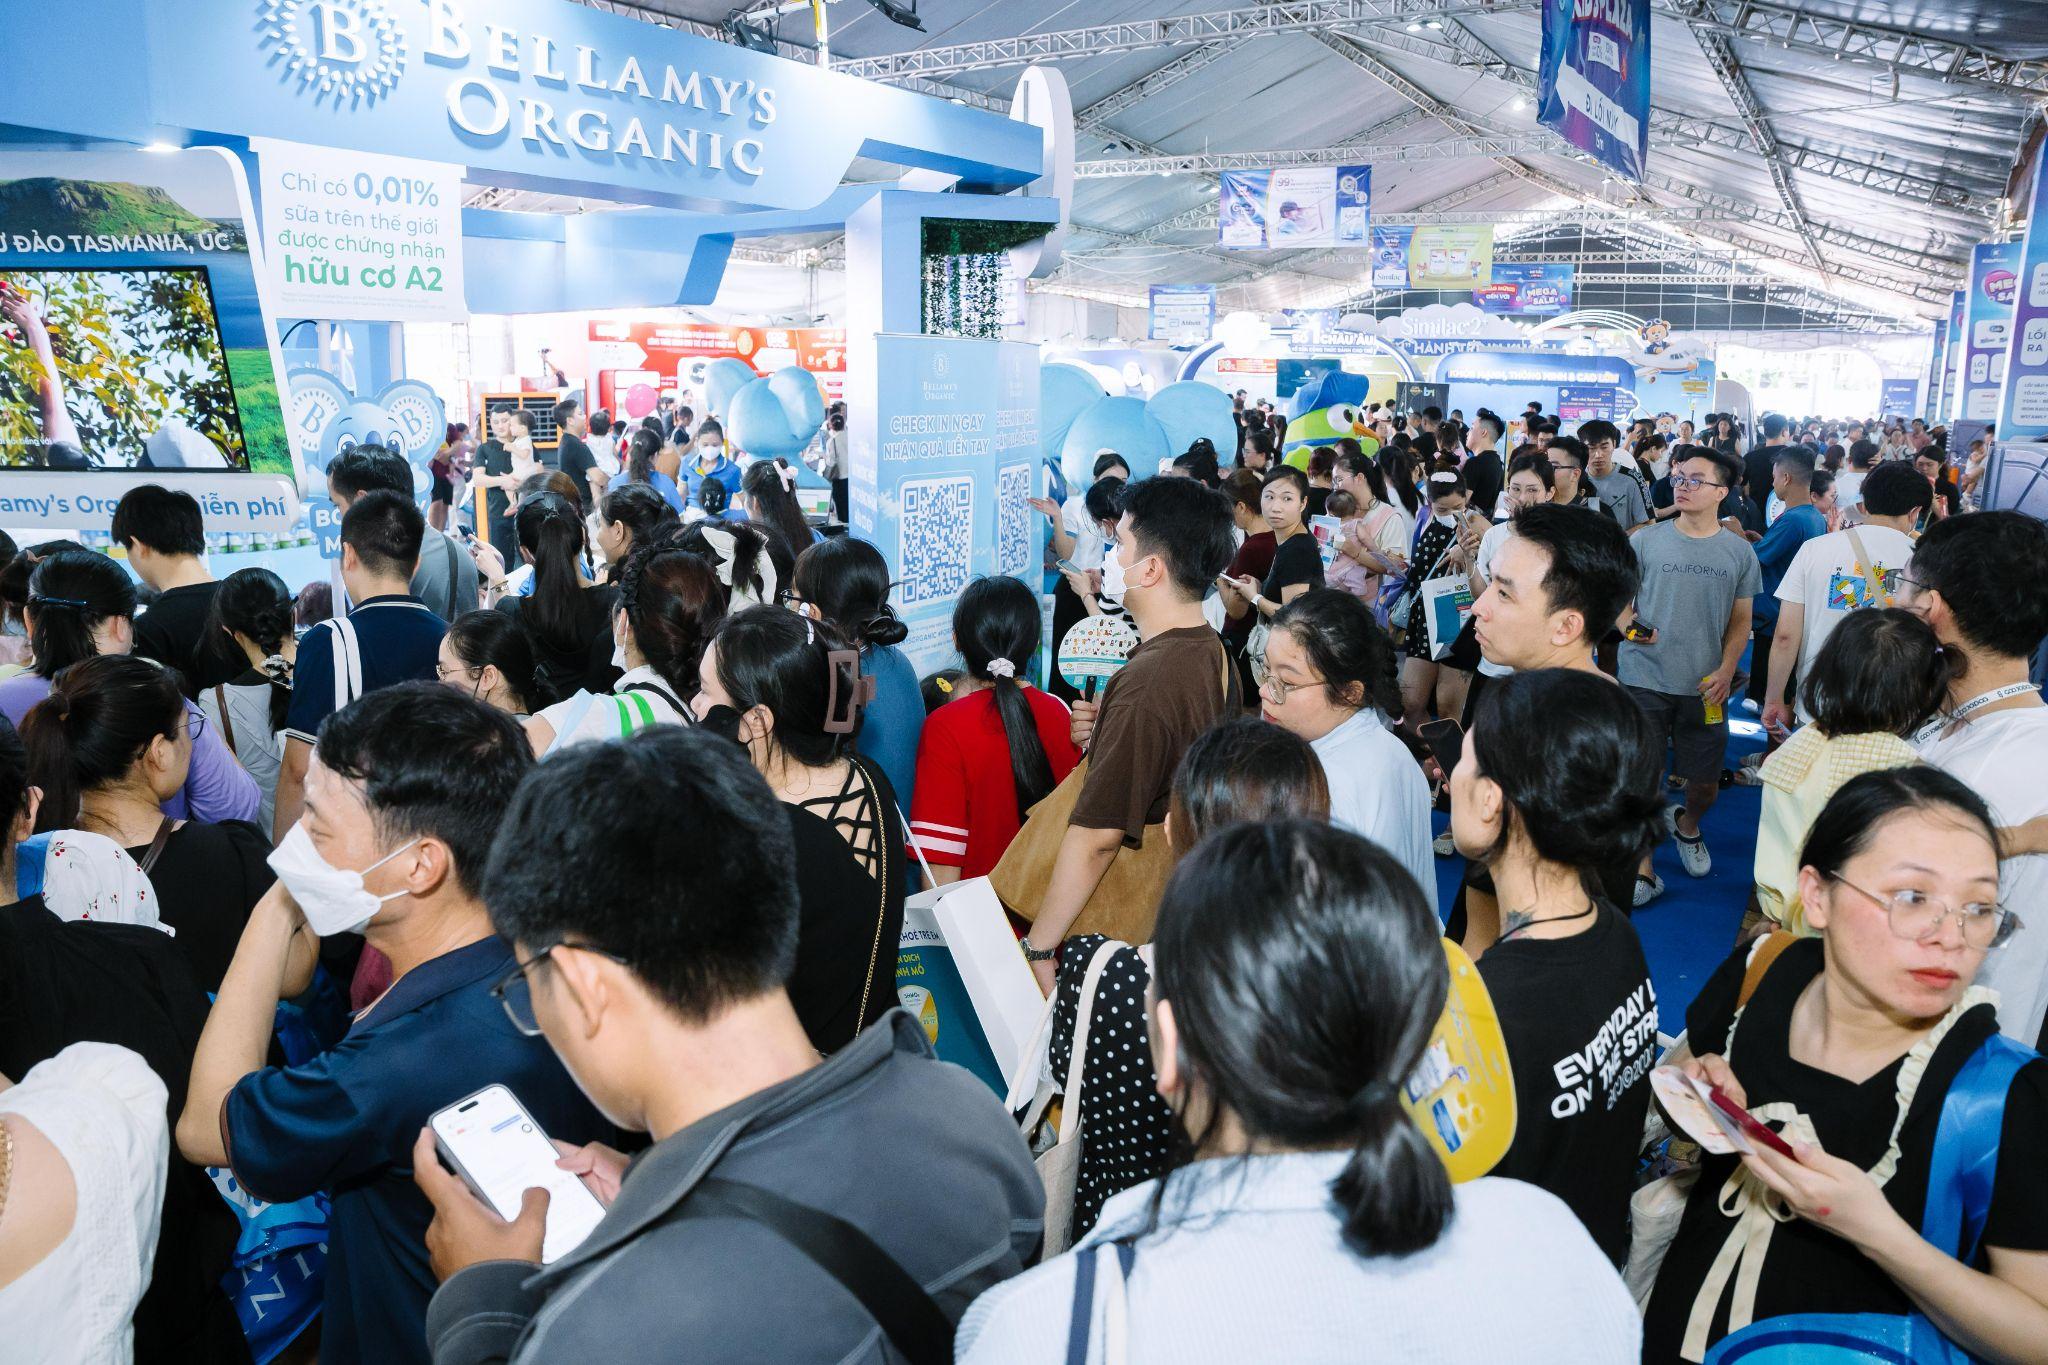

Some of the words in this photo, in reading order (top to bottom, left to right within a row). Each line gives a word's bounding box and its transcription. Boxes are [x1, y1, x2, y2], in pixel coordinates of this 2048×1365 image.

[314, 3, 367, 62] B
[424, 0, 776, 124] BELLAMY'S
[446, 77, 764, 176] ORGANIC
[281, 172, 317, 192] Chỉ
[323, 179, 347, 196] có
[353, 172, 439, 207] 0,01%
[284, 204, 319, 223] sữa
[325, 209, 365, 229] trên
[371, 212, 401, 231] thế
[406, 218, 438, 236] giới
[13, 229, 65, 253] ĐẢO
[68, 232, 195, 254] TASMANIA,
[278, 229, 329, 252] được
[335, 234, 394, 259] chứng
[400, 241, 445, 262] nhận
[285, 254, 349, 285] hữu
[360, 265, 397, 289] cơ
[404, 265, 443, 291] A2
[1527, 287, 1558, 297] MEGA
[1401, 316, 1467, 337] Similac
[2027, 328, 2046, 340] LỐI
[2027, 344, 2043, 352] RA
[300, 402, 325, 433] B
[401, 408, 422, 436] B
[890, 415, 936, 434] CHECK
[937, 414, 950, 433] IN
[951, 413, 986, 433] NGAY
[884, 438, 917, 463] NHẬN
[919, 437, 944, 459] QUÀ
[971, 439, 990, 455] TAY
[247, 497, 286, 520] phí
[1662, 563, 1728, 578] CALIFORNIA
[1553, 984, 1646, 1089] EVERYDAY
[1551, 1078, 1593, 1119] ON
[1599, 1040, 1622, 1090] THE
